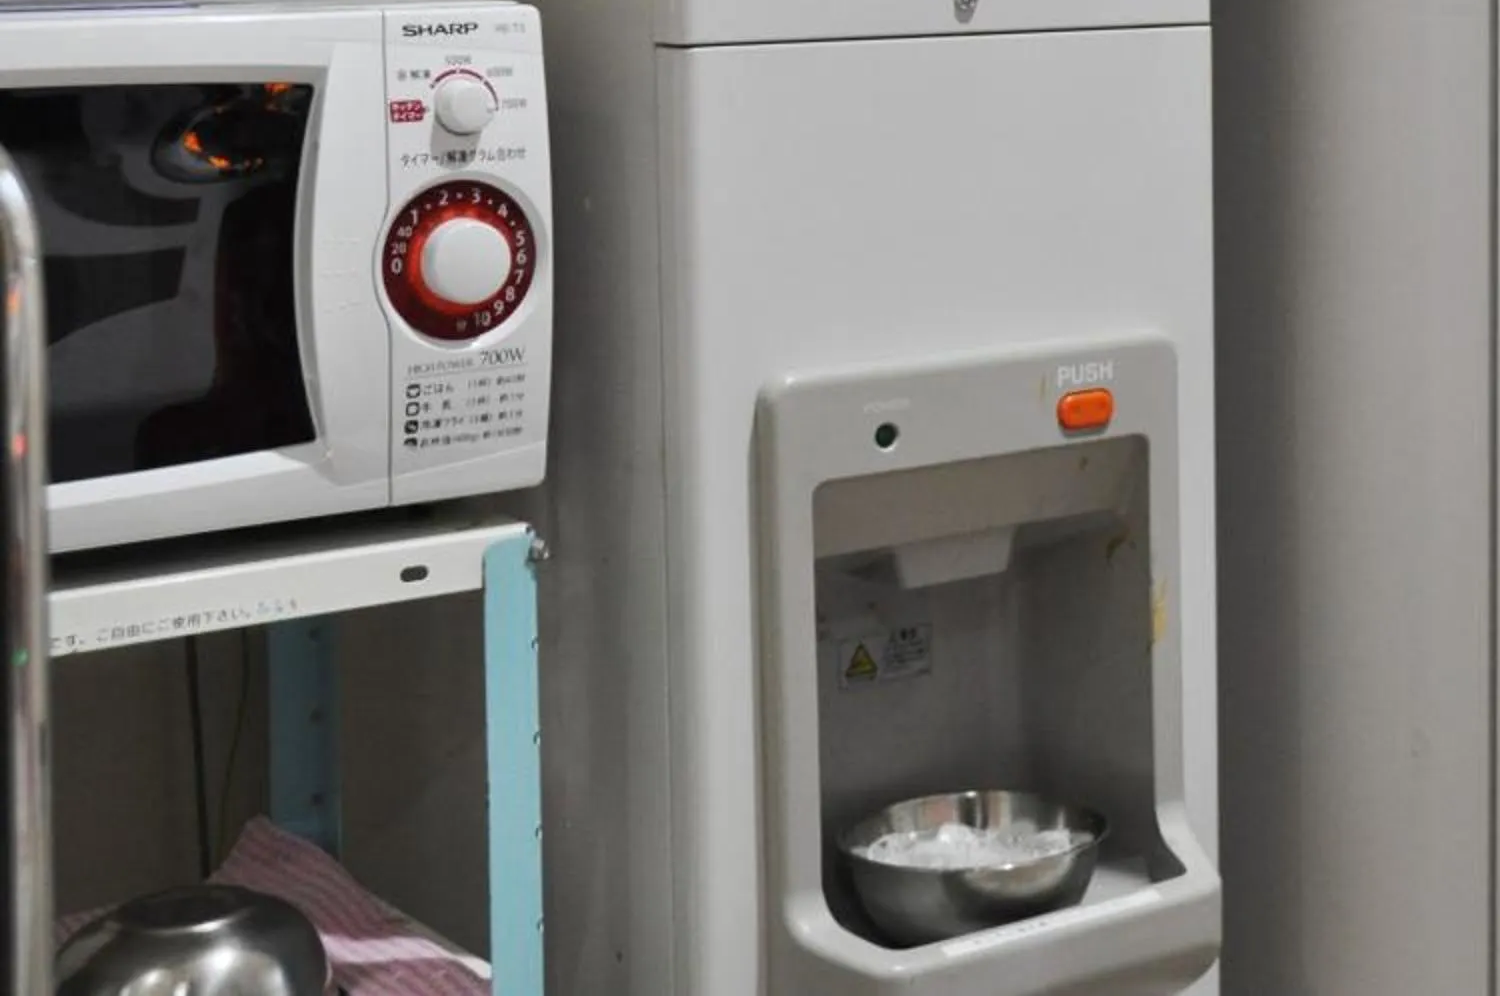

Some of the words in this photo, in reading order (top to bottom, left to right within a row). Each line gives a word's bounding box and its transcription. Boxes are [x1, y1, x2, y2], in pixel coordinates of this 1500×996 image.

[402, 22, 479, 38] SHARP
[438, 190, 449, 206] 2
[471, 188, 482, 204] 3
[497, 203, 509, 218] 4
[515, 230, 526, 246] 5
[516, 250, 527, 265] 6
[514, 269, 524, 285] 7
[505, 286, 516, 302] 8
[493, 300, 505, 316] 9
[1057, 360, 1115, 387] PUSH
